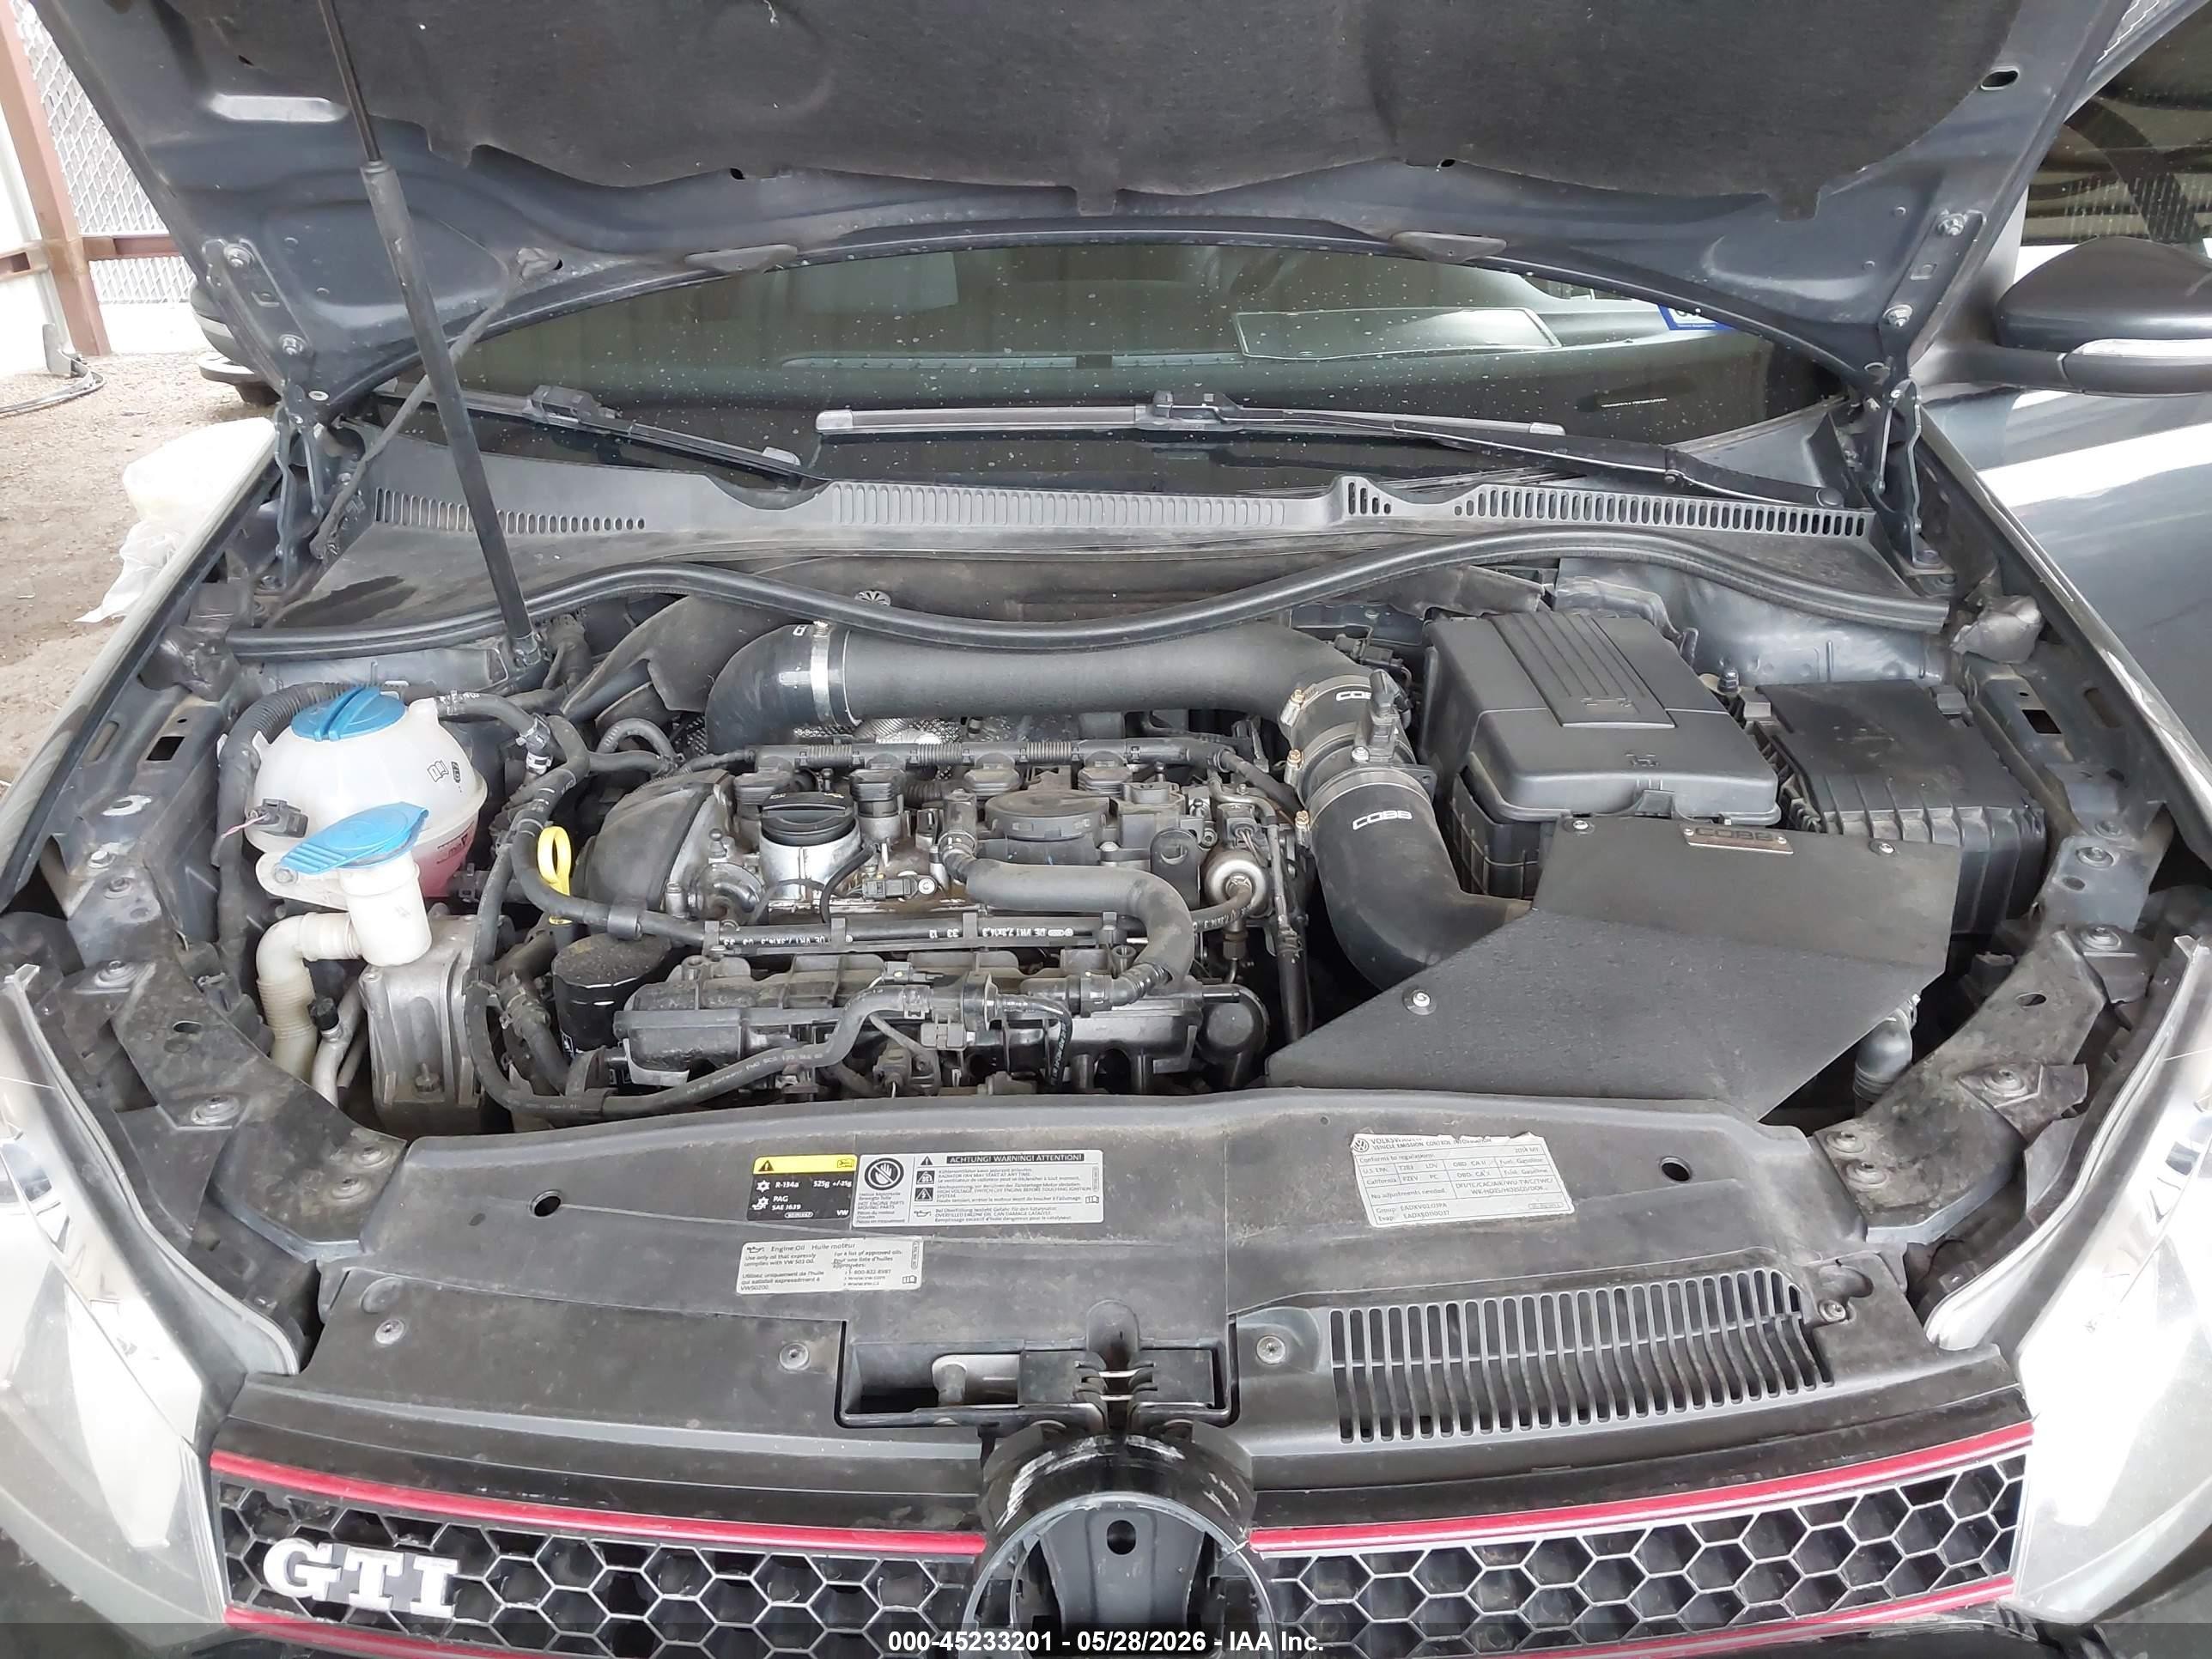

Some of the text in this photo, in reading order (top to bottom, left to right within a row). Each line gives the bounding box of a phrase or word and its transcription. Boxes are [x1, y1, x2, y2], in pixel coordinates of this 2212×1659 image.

[1335, 690, 1371, 701] COB
[1352, 810, 1413, 830] COBB
[1696, 827, 1773, 842] COBB
[813, 1180, 830, 1188] 525g
[1382, 1190, 1421, 1200] adjustments
[264, 1536, 460, 1620] GTI
